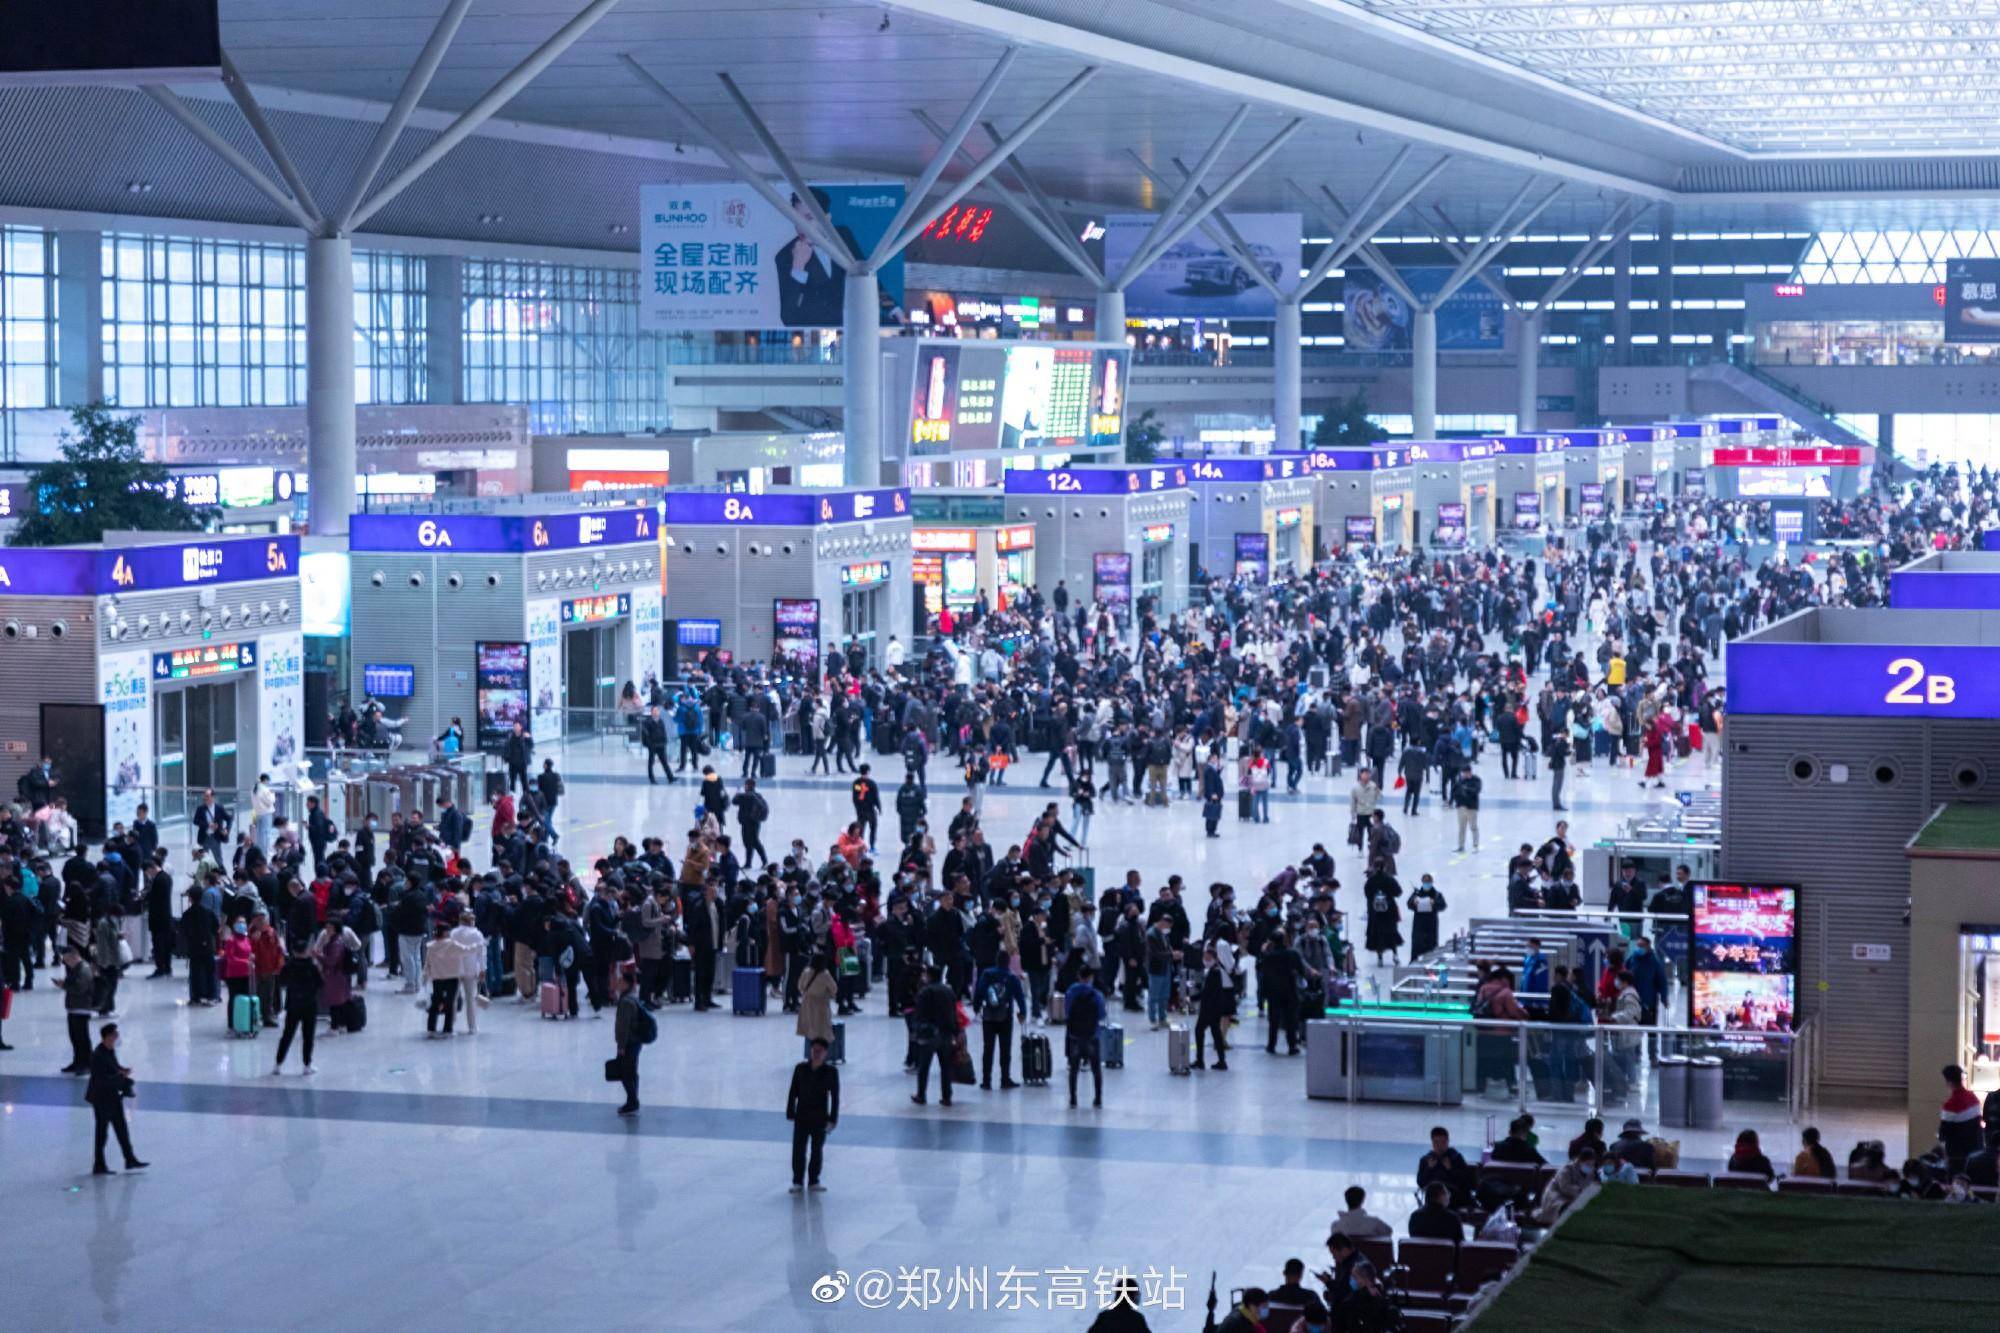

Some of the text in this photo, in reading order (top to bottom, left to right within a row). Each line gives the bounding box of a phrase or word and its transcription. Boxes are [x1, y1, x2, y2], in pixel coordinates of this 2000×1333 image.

[654, 213, 707, 223] SUNHOO
[654, 242, 758, 267] 全屋定制
[654, 271, 759, 295] 现场配齐
[1961, 282, 1997, 300] 慕思
[1192, 462, 1223, 478] 14A
[1047, 473, 1082, 491] 12A
[724, 498, 753, 521] 8A
[821, 498, 833, 520] 8A
[894, 493, 905, 513] 9A
[418, 520, 452, 547] 6A
[533, 520, 549, 547] 6A
[635, 513, 649, 538] 7A
[267, 542, 287, 572] 5A
[112, 554, 134, 586] 4A
[241, 645, 253, 665] 5A
[156, 658, 169, 676] 4A
[1884, 658, 1956, 704] 2B
